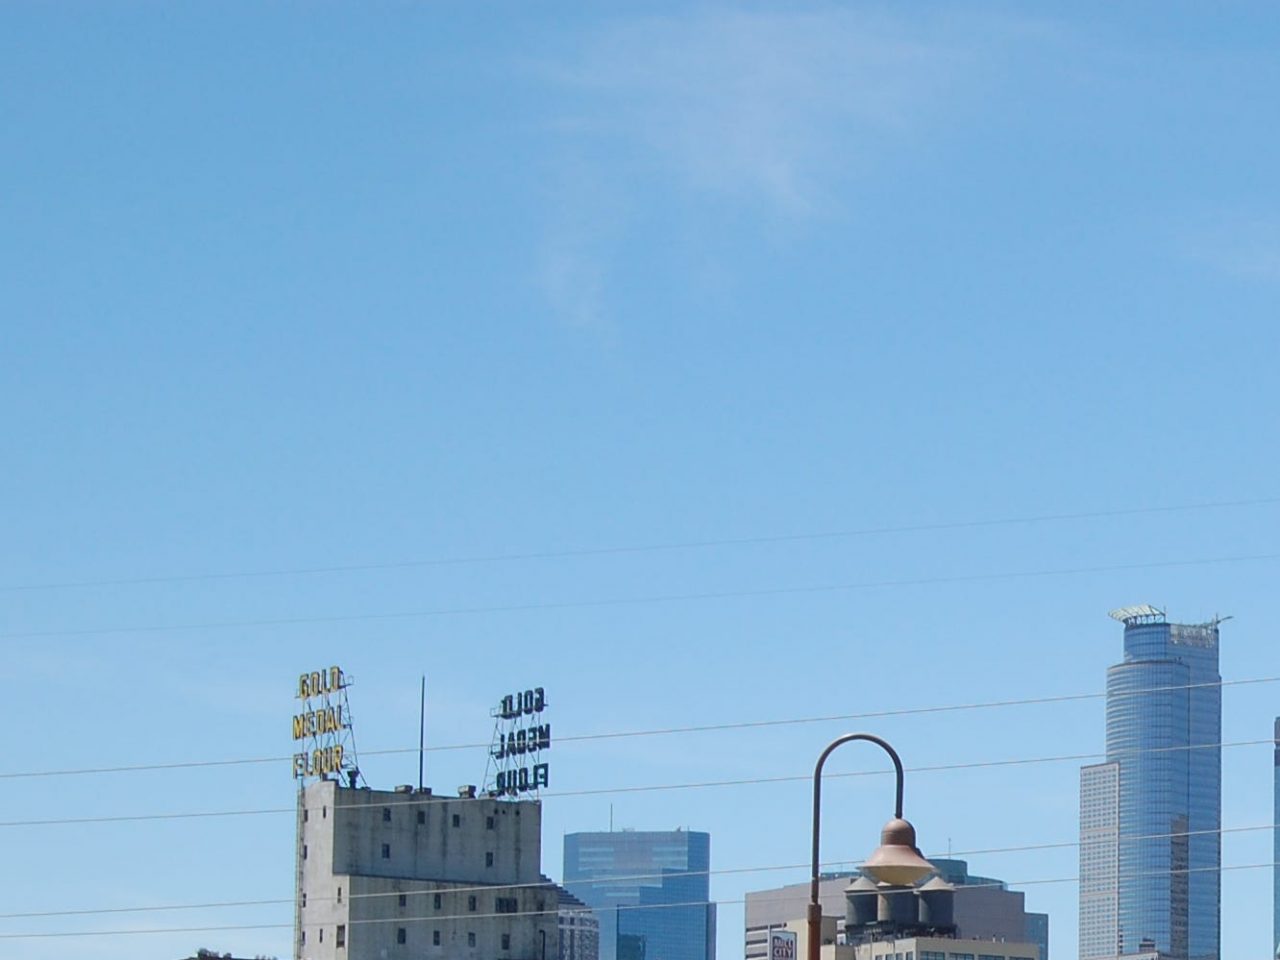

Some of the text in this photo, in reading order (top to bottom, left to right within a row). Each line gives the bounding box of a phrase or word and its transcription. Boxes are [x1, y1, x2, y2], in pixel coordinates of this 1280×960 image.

[299, 666, 342, 699] GOLD
[293, 705, 345, 741] MEDAL
[293, 744, 344, 779] FLOUR
[773, 937, 793, 949] MILL
[773, 947, 793, 958] CITY
